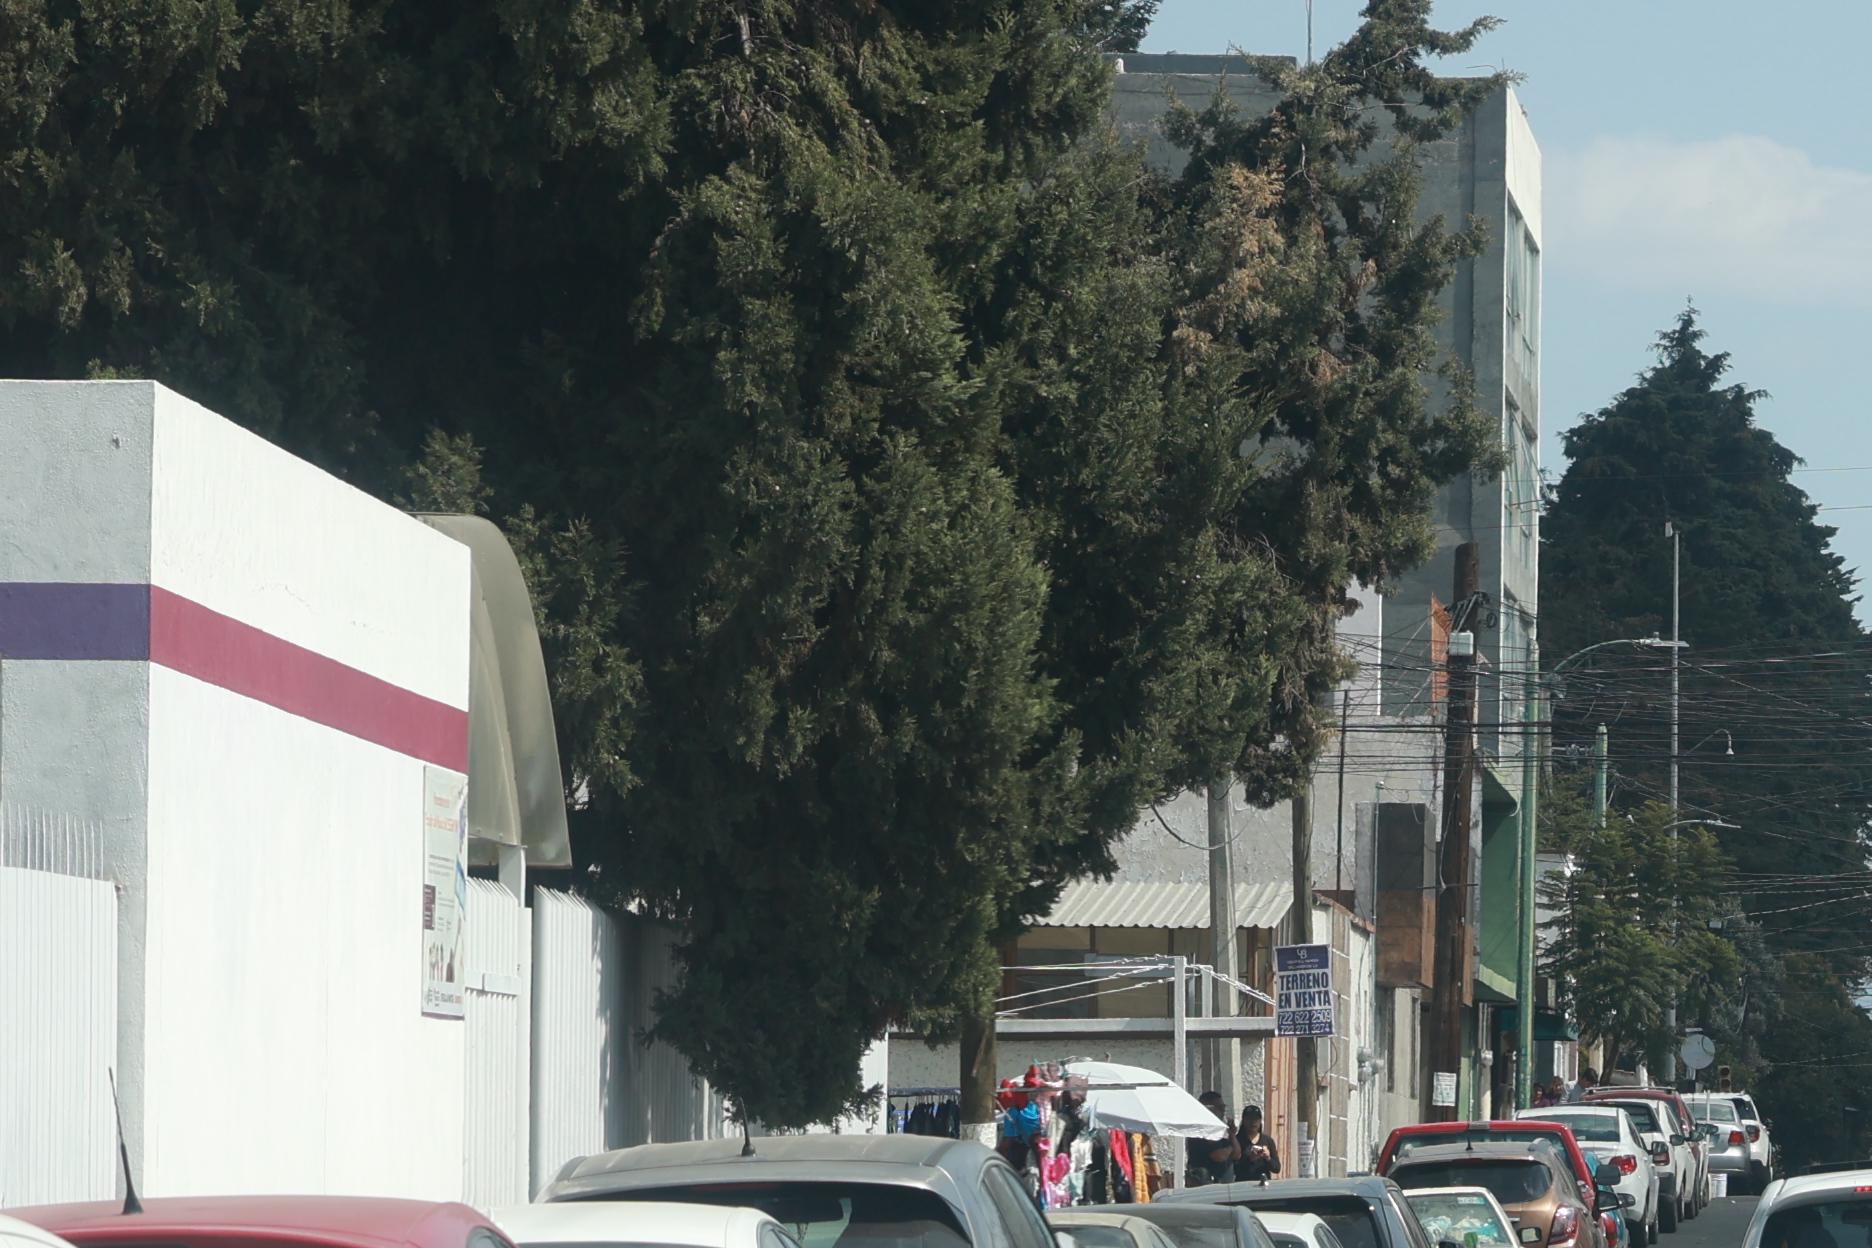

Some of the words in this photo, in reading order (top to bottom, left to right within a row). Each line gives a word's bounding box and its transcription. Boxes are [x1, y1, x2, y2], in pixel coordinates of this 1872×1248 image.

[1279, 972, 1329, 992] TERRENO
[1278, 991, 1292, 1010] EN
[1295, 990, 1331, 1009] VENTA
[1278, 1011, 1293, 1025] 722
[1294, 1011, 1310, 1024] 622
[1280, 1026, 1295, 1035] 722
[1296, 1025, 1309, 1034] 271
[1311, 1024, 1331, 1034] 3274
